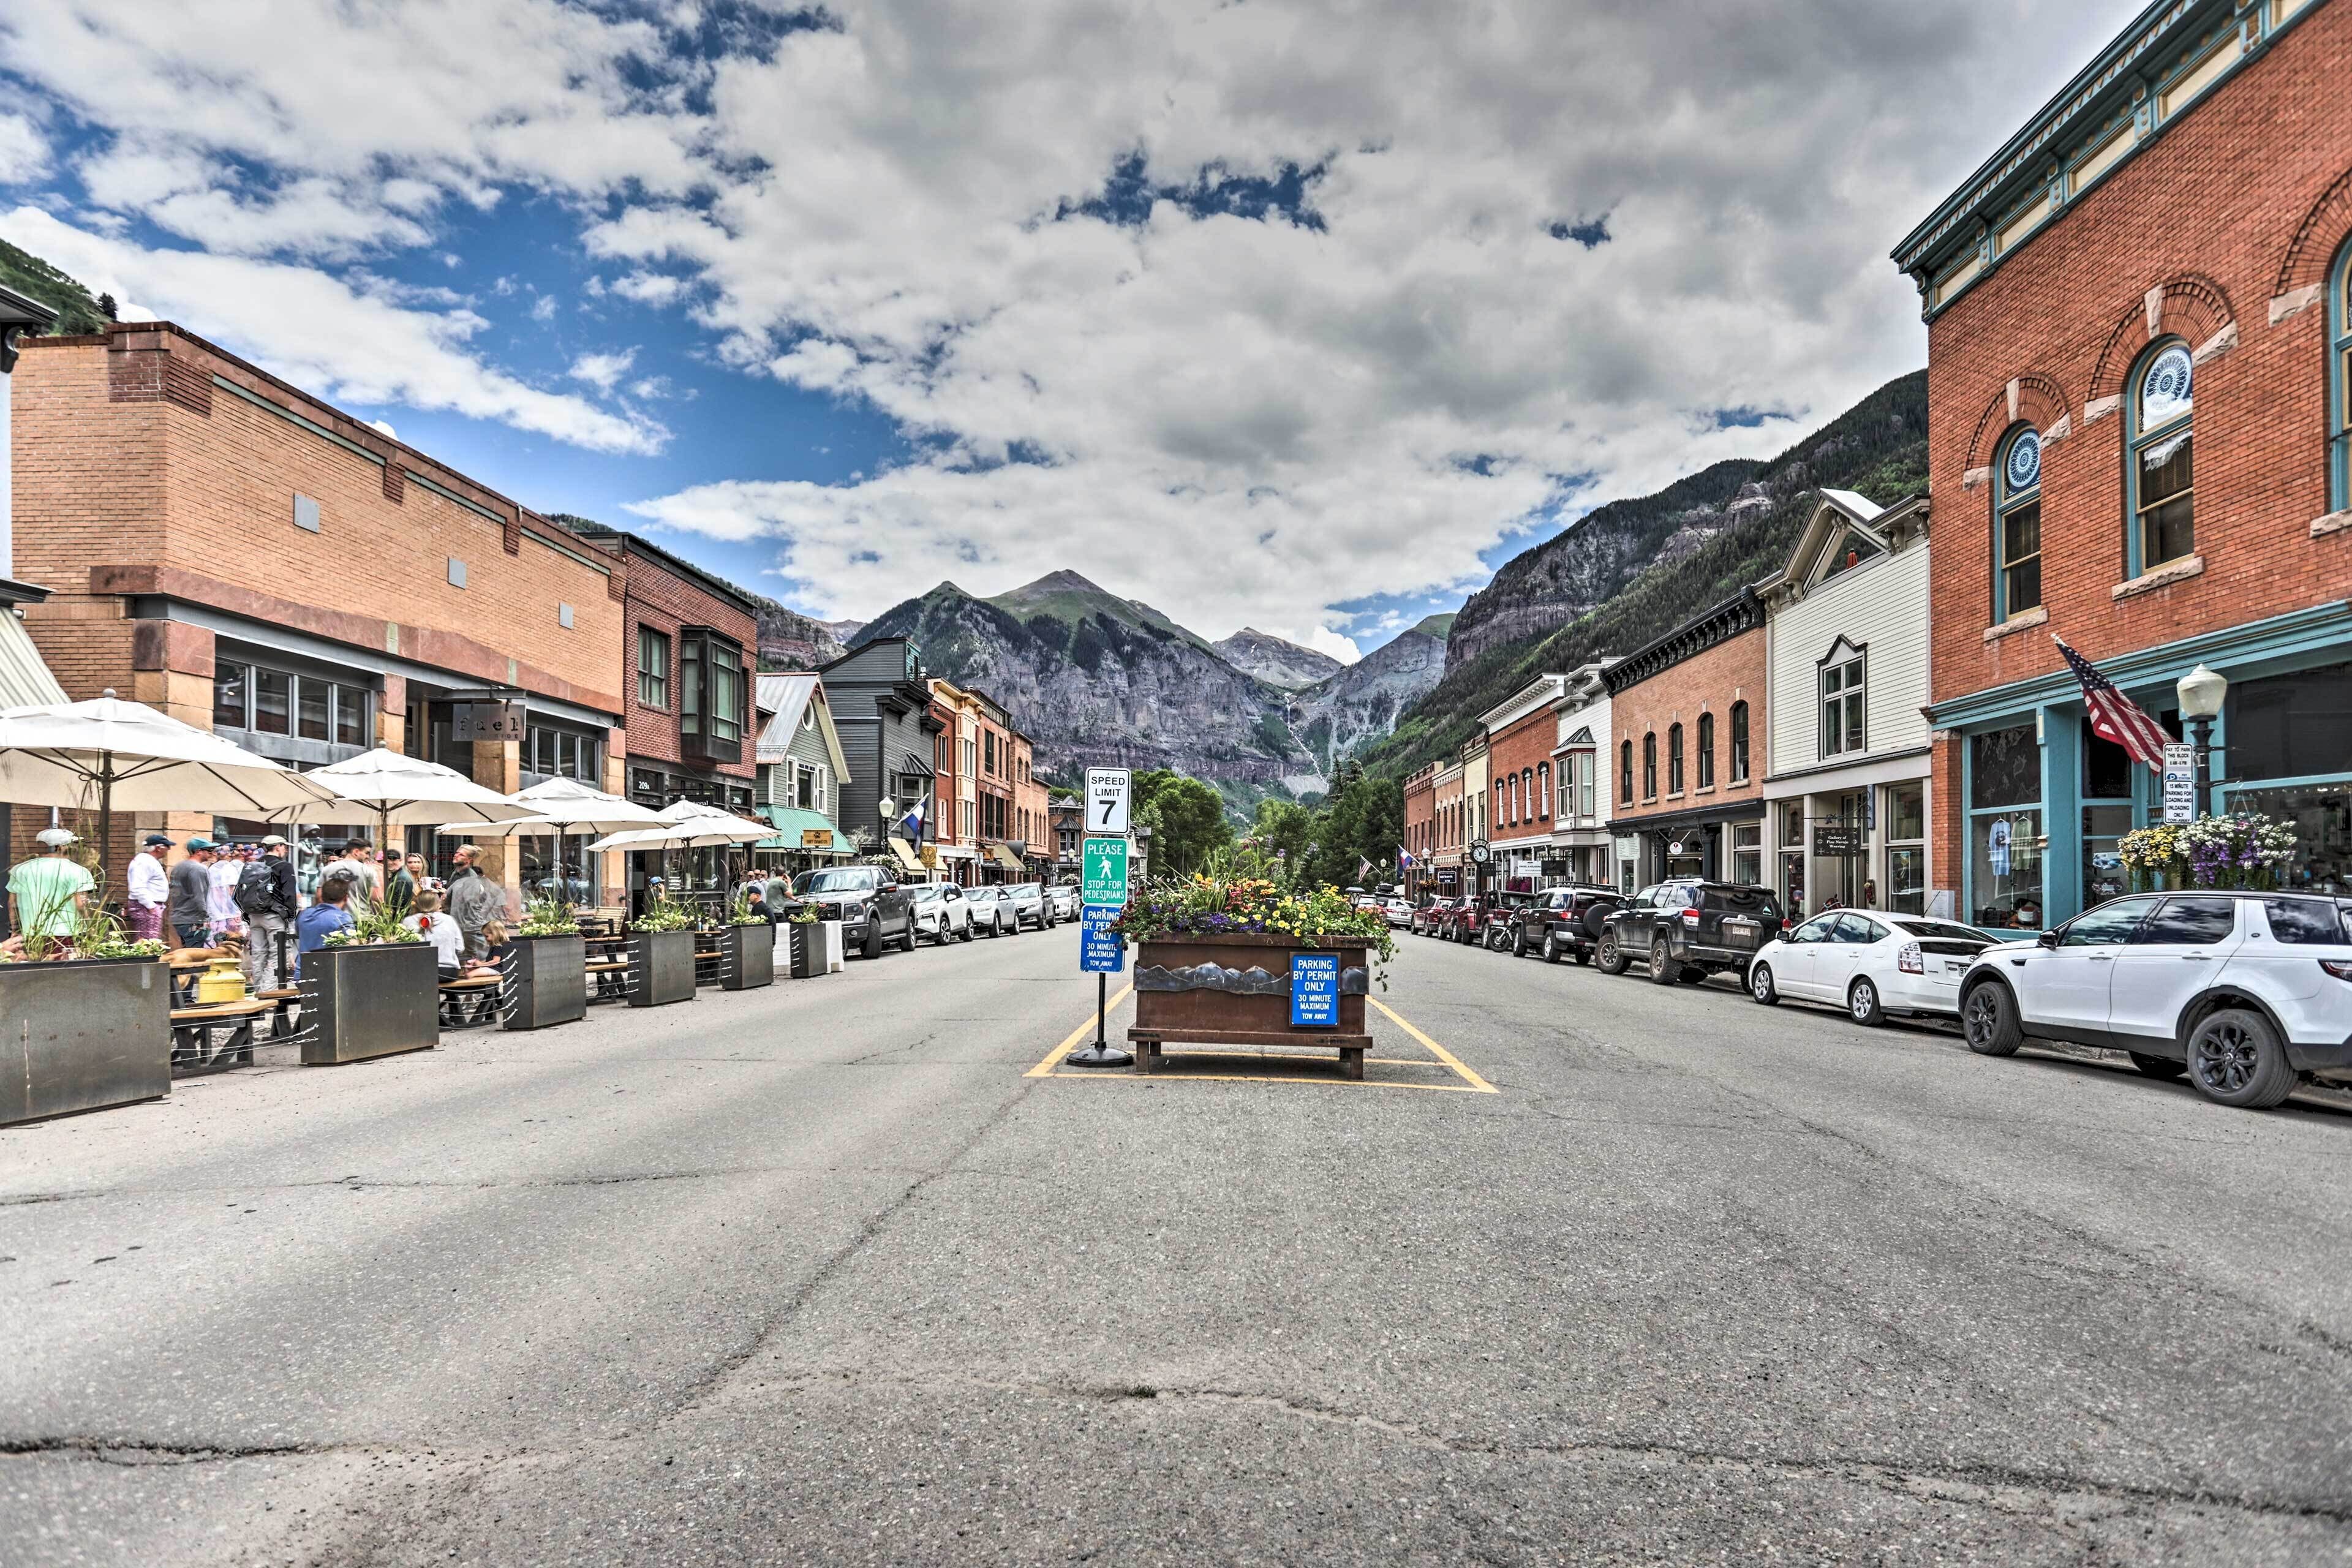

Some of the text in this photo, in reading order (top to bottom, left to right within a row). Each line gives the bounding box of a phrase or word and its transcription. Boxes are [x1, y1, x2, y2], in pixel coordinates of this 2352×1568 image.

[1091, 776, 1125, 785] SPEED
[1095, 788, 1121, 797] LIMIT
[1099, 800, 1116, 824] 7
[1087, 844, 1123, 855] PLEASE
[1087, 880, 1122, 889] STOP FOR
[1084, 890, 1125, 899] PEDESTRIANS
[1088, 911, 1120, 921] PARKING
[1083, 921, 1093, 930] BY
[1093, 931, 1112, 941] ONLY
[1298, 960, 1332, 970] PARKING
[1293, 971, 1336, 981] BY PERMIT
[1304, 981, 1325, 992] ONLY
